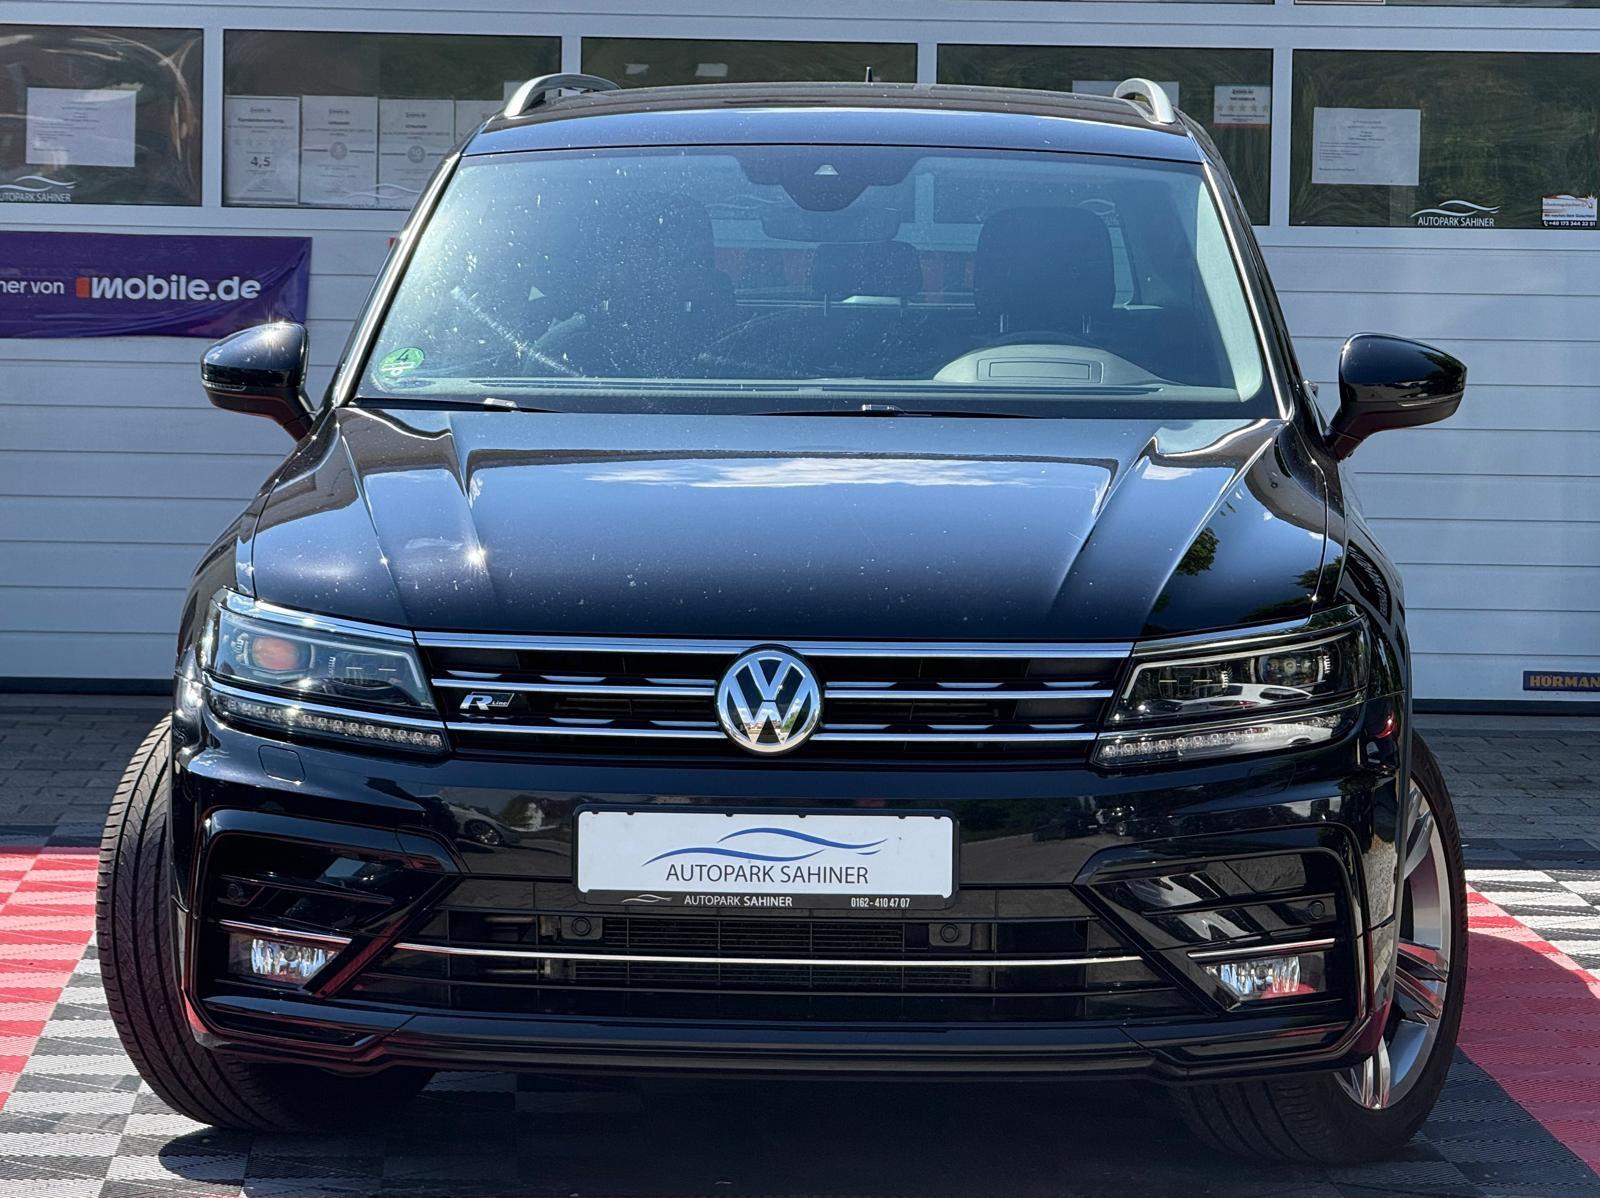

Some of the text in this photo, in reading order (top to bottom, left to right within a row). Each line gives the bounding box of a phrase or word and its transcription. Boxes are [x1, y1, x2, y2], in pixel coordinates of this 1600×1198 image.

[250, 156, 271, 168] 4,5
[36, 193, 71, 202] SAHINER
[1417, 216, 1495, 227] AUTOPARK SAHINER
[30, 281, 64, 294] von
[91, 274, 261, 301] mobile.de
[666, 864, 869, 884] AUTOPARK SAHINER
[684, 895, 793, 907] AUTOPARK SAHINER
